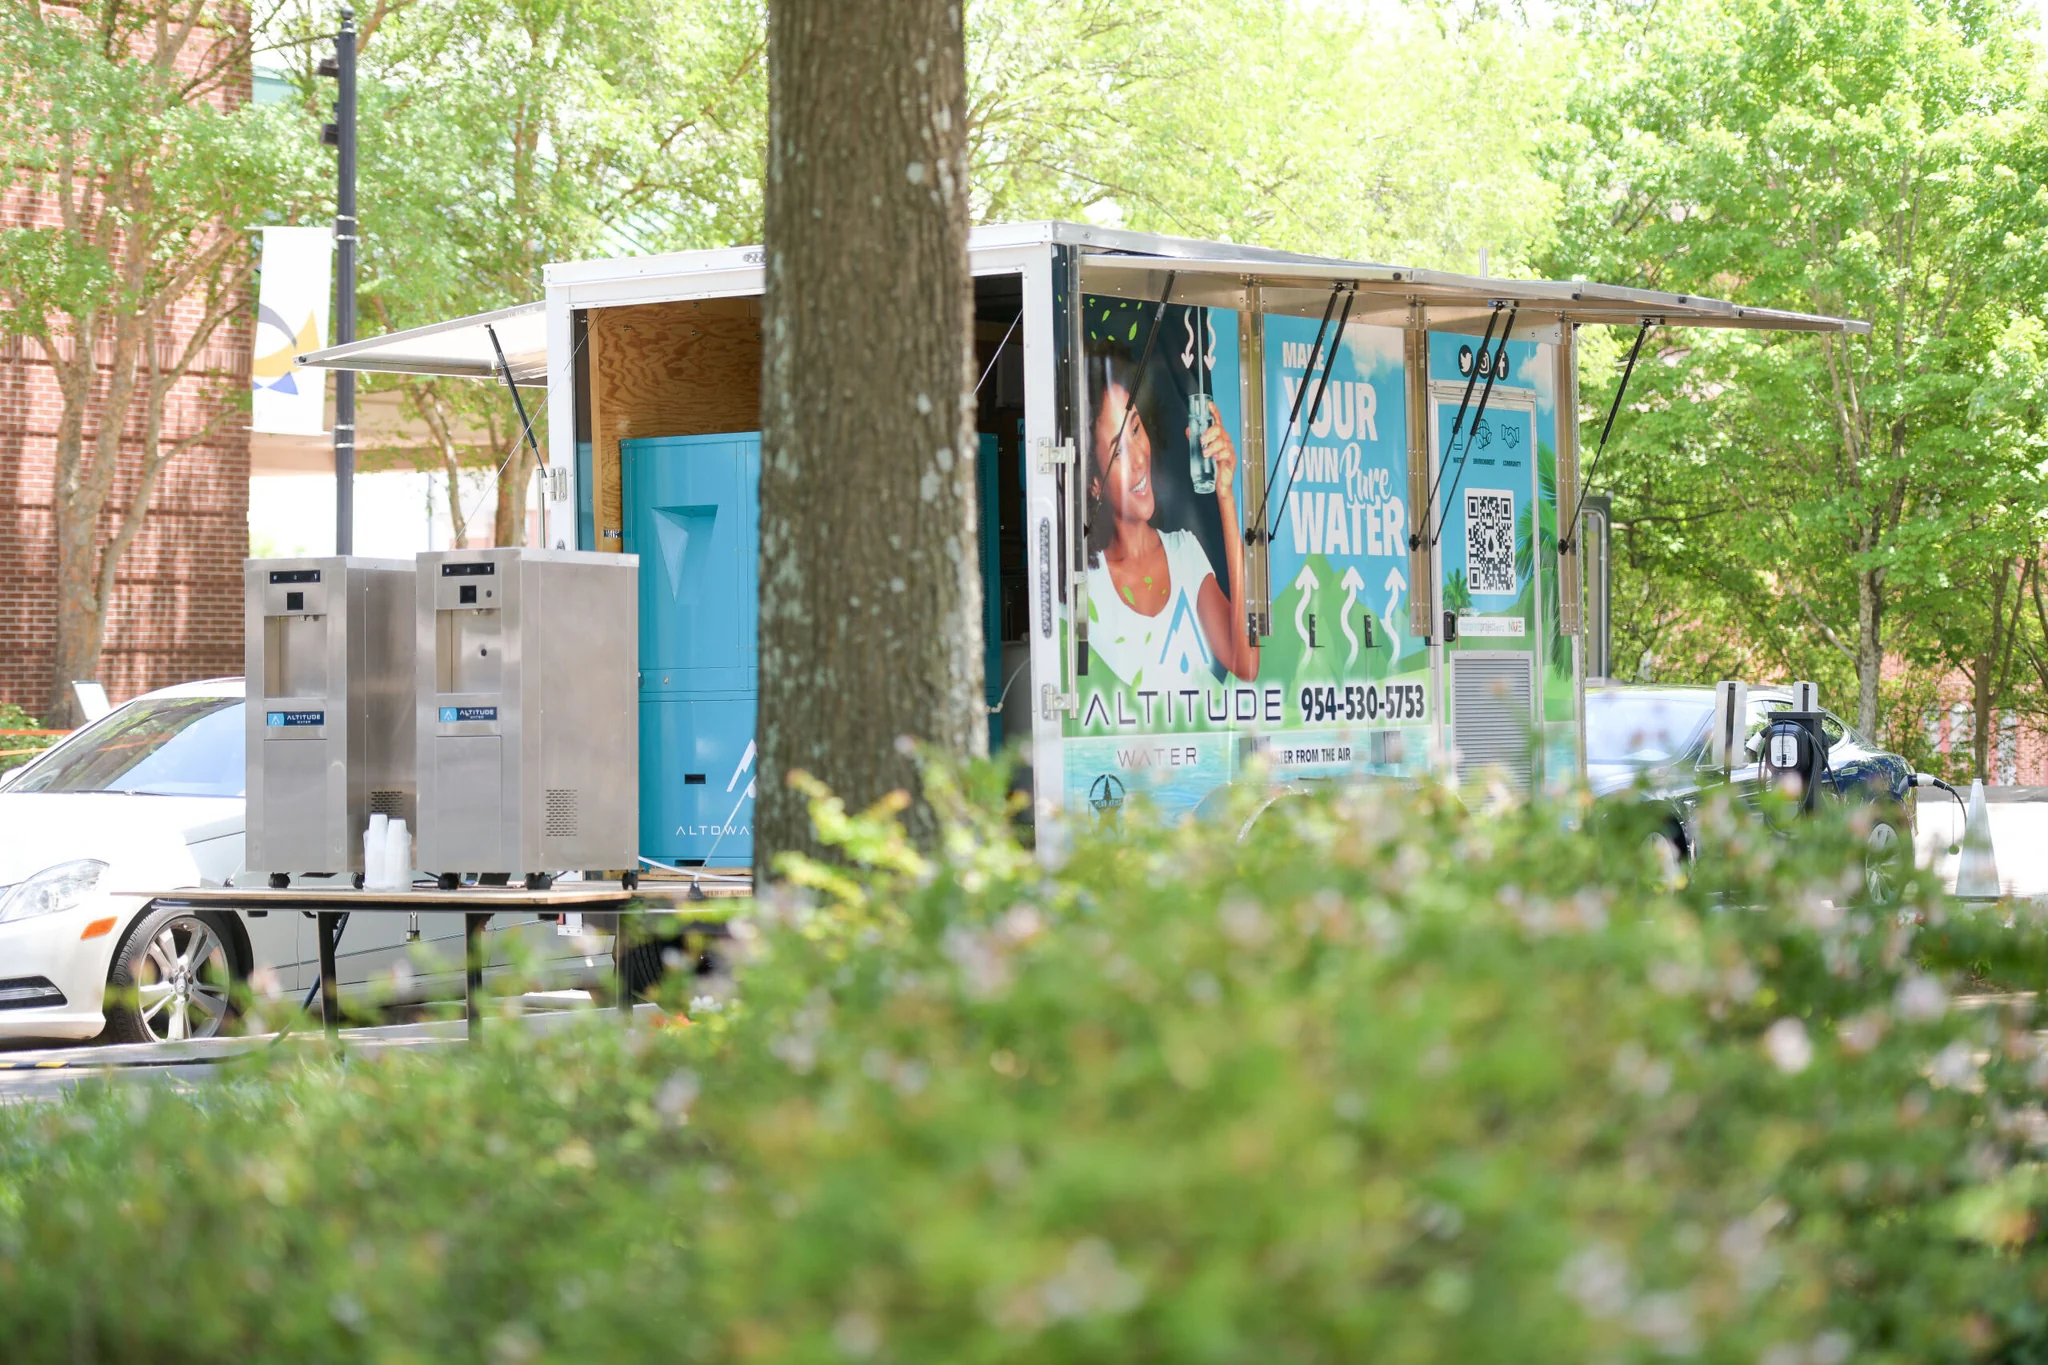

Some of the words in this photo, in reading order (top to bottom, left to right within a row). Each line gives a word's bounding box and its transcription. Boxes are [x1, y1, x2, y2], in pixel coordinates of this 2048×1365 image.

[1283, 376, 1379, 441] YOUR
[1287, 445, 1339, 483] OWN
[1339, 442, 1393, 502] Pure
[1289, 491, 1407, 557] WATER
[1085, 689, 1282, 726] ALTITUDE
[1301, 684, 1425, 722] 954-530-5753
[1117, 747, 1197, 768] WATER
[1296, 748, 1319, 763] FROM
[1321, 747, 1335, 762] THE
[1338, 747, 1351, 761] AIR
[676, 825, 755, 836] ALTOWA
